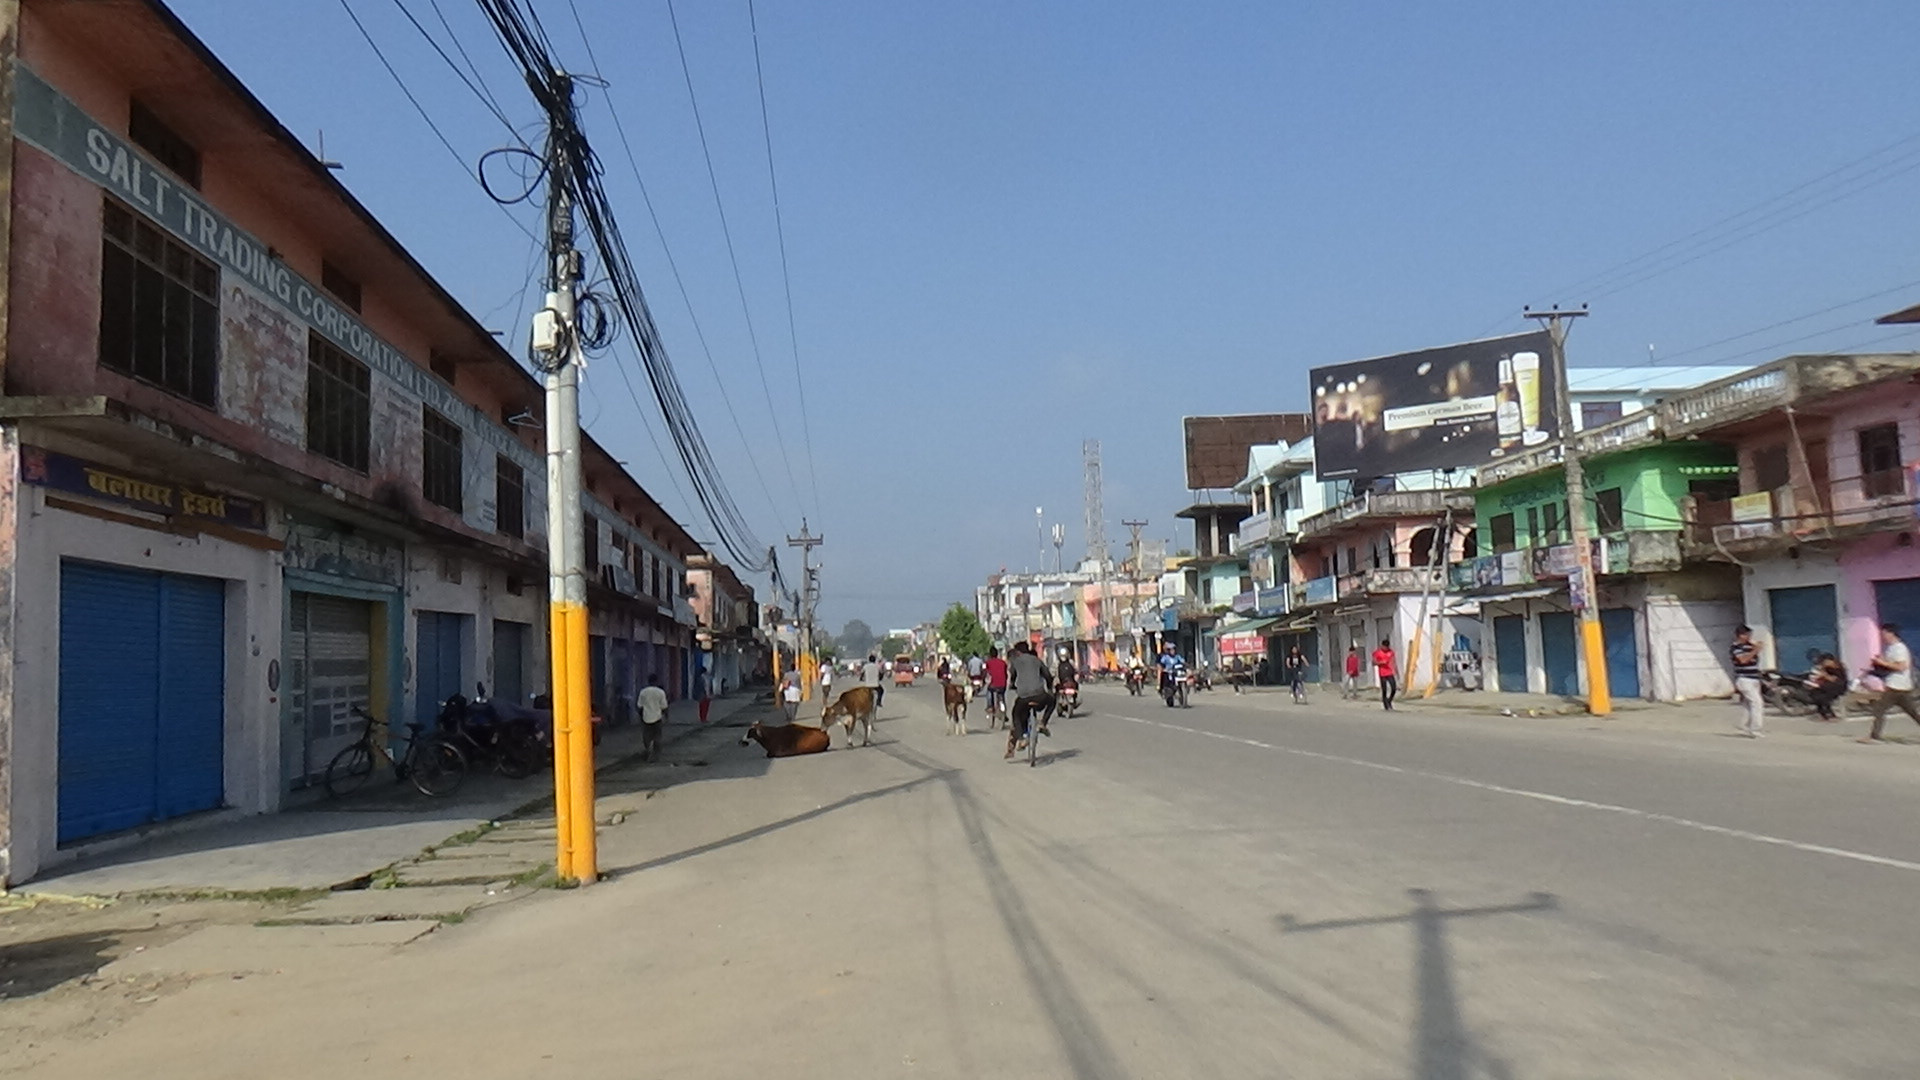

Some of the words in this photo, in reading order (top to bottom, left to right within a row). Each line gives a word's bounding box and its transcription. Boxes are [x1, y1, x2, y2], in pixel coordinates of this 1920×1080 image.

[86, 128, 171, 215] SALT
[179, 192, 291, 303] TRADING
[296, 284, 414, 391] CORPORATION
[1388, 410, 1427, 421] Premium
[1428, 405, 1462, 416] German
[1462, 401, 1483, 411] Beer
